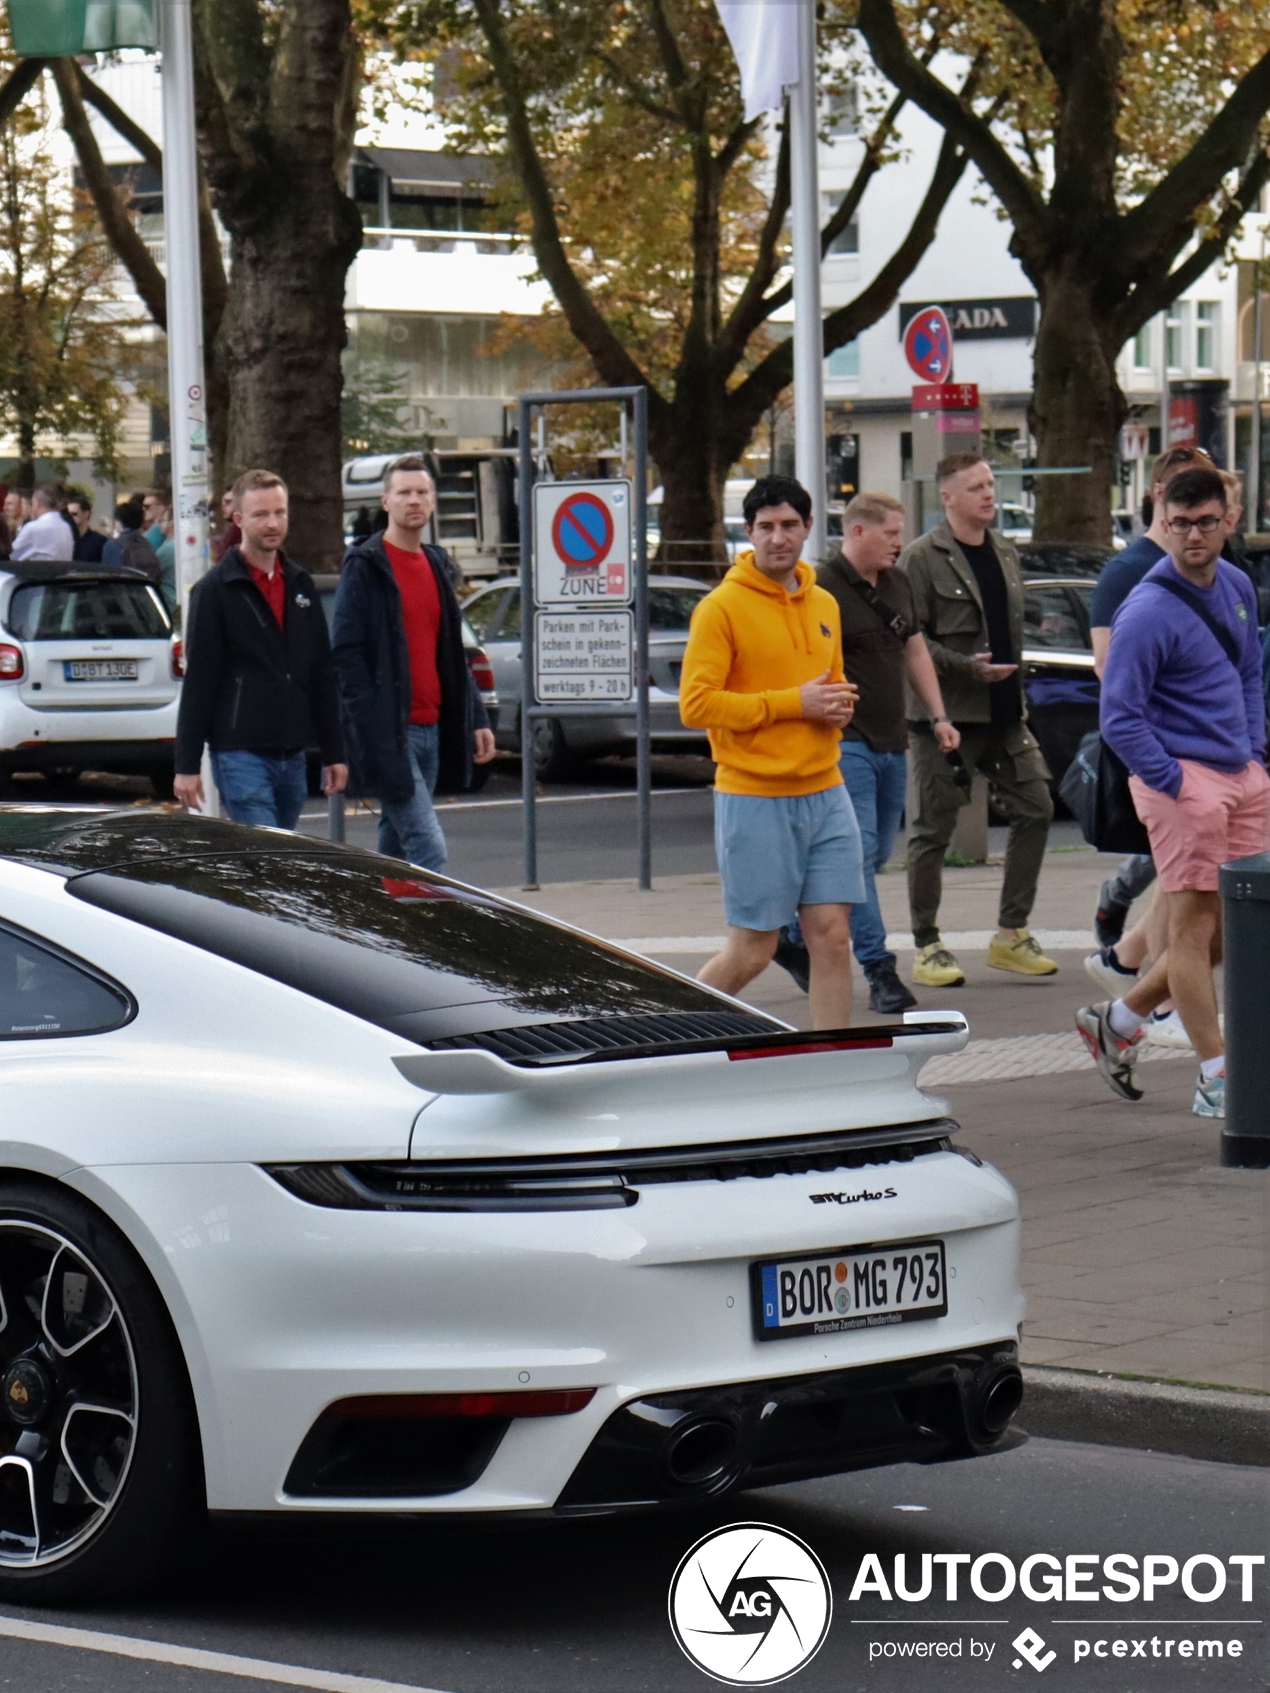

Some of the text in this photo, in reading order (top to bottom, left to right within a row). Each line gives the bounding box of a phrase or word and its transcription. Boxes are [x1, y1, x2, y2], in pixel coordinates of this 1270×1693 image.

[560, 576, 607, 595] ZONE
[543, 619, 625, 633] Parken mit Park-
[542, 638, 627, 653] schein in gekenn-
[542, 655, 627, 669] zeichneten Flächen
[543, 681, 586, 695] werktags
[589, 680, 595, 693] 9
[606, 680, 618, 693] 20
[621, 680, 627, 692] h
[780, 1252, 940, 1318] BOR MG 793
[814, 1312, 902, 1334] Porsche Zentrum Niederrhein
